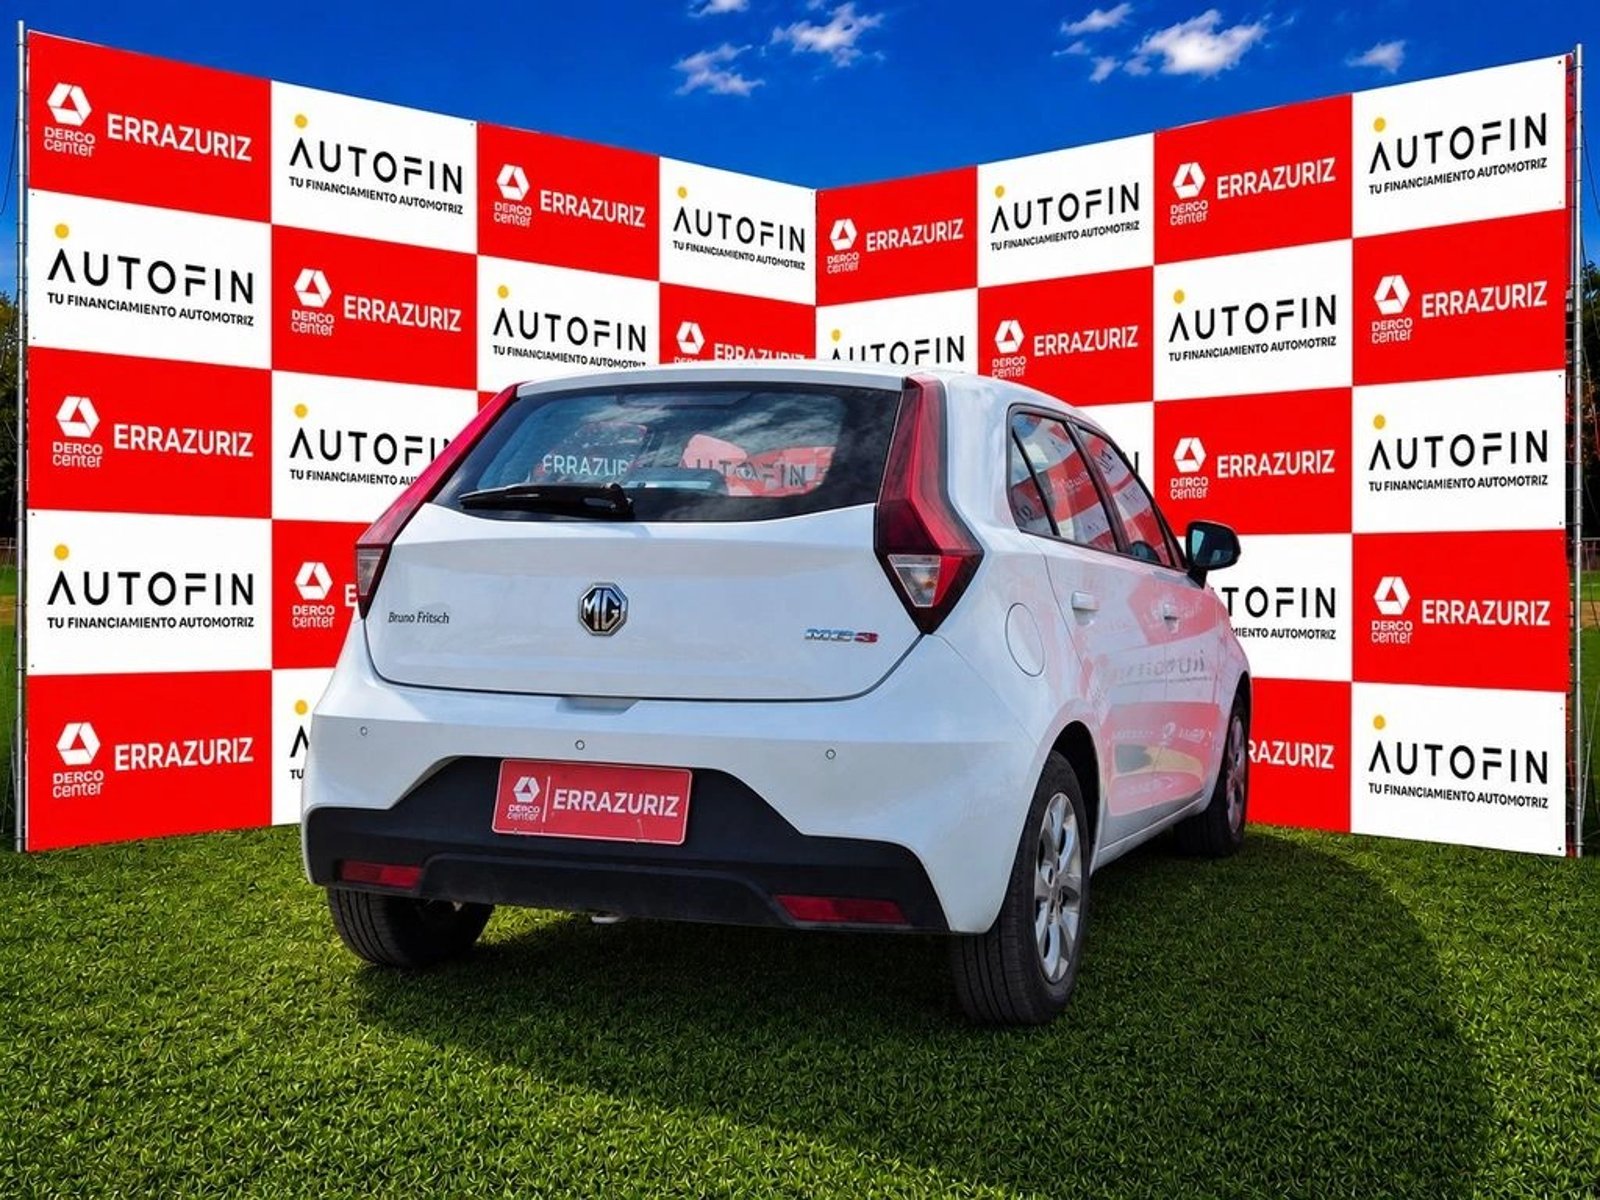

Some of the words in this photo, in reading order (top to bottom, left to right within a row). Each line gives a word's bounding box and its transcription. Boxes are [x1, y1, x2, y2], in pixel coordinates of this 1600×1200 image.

[44, 138, 94, 157] center
[45, 127, 95, 144] DERCO
[108, 113, 252, 161] ERRAZURIZ
[1370, 113, 1546, 174] AUTOFIN
[290, 138, 463, 194] AUTOFIN
[1217, 157, 1335, 199] ERRAZURIZ
[1369, 184, 1381, 194] TU
[1384, 169, 1475, 192] FINANCIAMIENTO
[1477, 158, 1547, 178] AUTOMOTRIZ
[289, 176, 303, 187] TU
[306, 179, 397, 204] FINANCIAMIENTO
[399, 196, 463, 214] AUTOMOTRIZ
[991, 182, 1139, 233] AUTOFIN
[1171, 200, 1208, 214] DERCO
[494, 202, 531, 216] DERCO
[494, 212, 531, 226] center
[540, 190, 645, 227] ERRAZURIZ
[1171, 211, 1207, 225] center
[673, 207, 805, 253] AUTOFIN
[867, 219, 963, 252] ERRAZURIZ
[991, 242, 1002, 251] TU
[1004, 230, 1079, 248] FINANCIAMIENTO
[1081, 221, 1139, 238] AUTOMOTRIZ
[673, 241, 684, 250] TU
[686, 243, 755, 261] FINANCIAMIENTO
[756, 253, 805, 270] AUTOMOTRIZ
[827, 252, 859, 264] DERCO
[827, 261, 858, 274] center
[48, 249, 253, 304] AUTOFIN
[48, 292, 64, 304] TU
[68, 295, 176, 317] FINANCIAMIENTO
[179, 308, 253, 326] AUTOMOTRIZ
[1422, 281, 1547, 318] ERRAZURIZ
[292, 309, 334, 324] DERCO
[344, 295, 461, 331] ERRAZURIZ
[1169, 295, 1336, 342] AUTOFIN
[1372, 318, 1412, 332] DERCO
[292, 320, 333, 335] center
[493, 308, 646, 352] AUTOFIN
[1372, 329, 1411, 343] center
[1034, 326, 1138, 357] ERRAZURIZ
[1169, 353, 1181, 361] TU
[1183, 343, 1268, 360] FINANCIAMIENTO
[1270, 336, 1336, 351] AUTOMOTRIZ
[493, 345, 505, 355] TU
[507, 347, 588, 365] FINANCIAMIENTO
[992, 356, 1027, 368] DERCO
[992, 366, 1026, 379] center
[53, 442, 102, 455] DERCO
[114, 424, 253, 457] ERRAZURIZ
[289, 427, 450, 466] AUTOFI
[1369, 430, 1547, 470] AUTOFIN
[53, 454, 102, 467] center
[1217, 450, 1335, 478] ERRAZURIZ
[290, 469, 304, 480] TU
[306, 470, 397, 485] FINANCIAMIENTO
[1171, 477, 1208, 488] DERCO
[1369, 480, 1381, 491] TU
[1384, 478, 1475, 490] FINANCIAMIENTO
[1477, 475, 1548, 488] AUTOMOTRIZ
[1171, 487, 1207, 499] center
[47, 571, 253, 606] AUTOFIN
[293, 605, 335, 616] DERCO
[583, 587, 621, 631] MG
[1221, 586, 1336, 618] TOFIN
[1422, 600, 1550, 625] ERRAZURIZ
[47, 617, 64, 628] TU
[68, 617, 176, 628] FINANCIAMIENTO
[179, 617, 254, 628] AUTOMOTRIZ
[293, 615, 334, 628] center
[388, 611, 415, 623] Bruno
[417, 611, 449, 624] Fritsch
[1372, 620, 1412, 632] DERCO
[1270, 628, 1336, 640] AUTOMOTRIZ
[1372, 631, 1412, 644] center
[115, 737, 253, 771] ERRAZURIZ
[1369, 741, 1547, 784] AUTOFIN
[53, 770, 104, 785] DERCO
[290, 769, 304, 779] TU
[53, 782, 103, 798] center
[553, 788, 679, 817] ERRAZURIZ
[1369, 783, 1381, 794] TU
[1384, 784, 1475, 802] FINANCIAMIENTO
[1477, 792, 1548, 808] AUTOMOTRIZ
